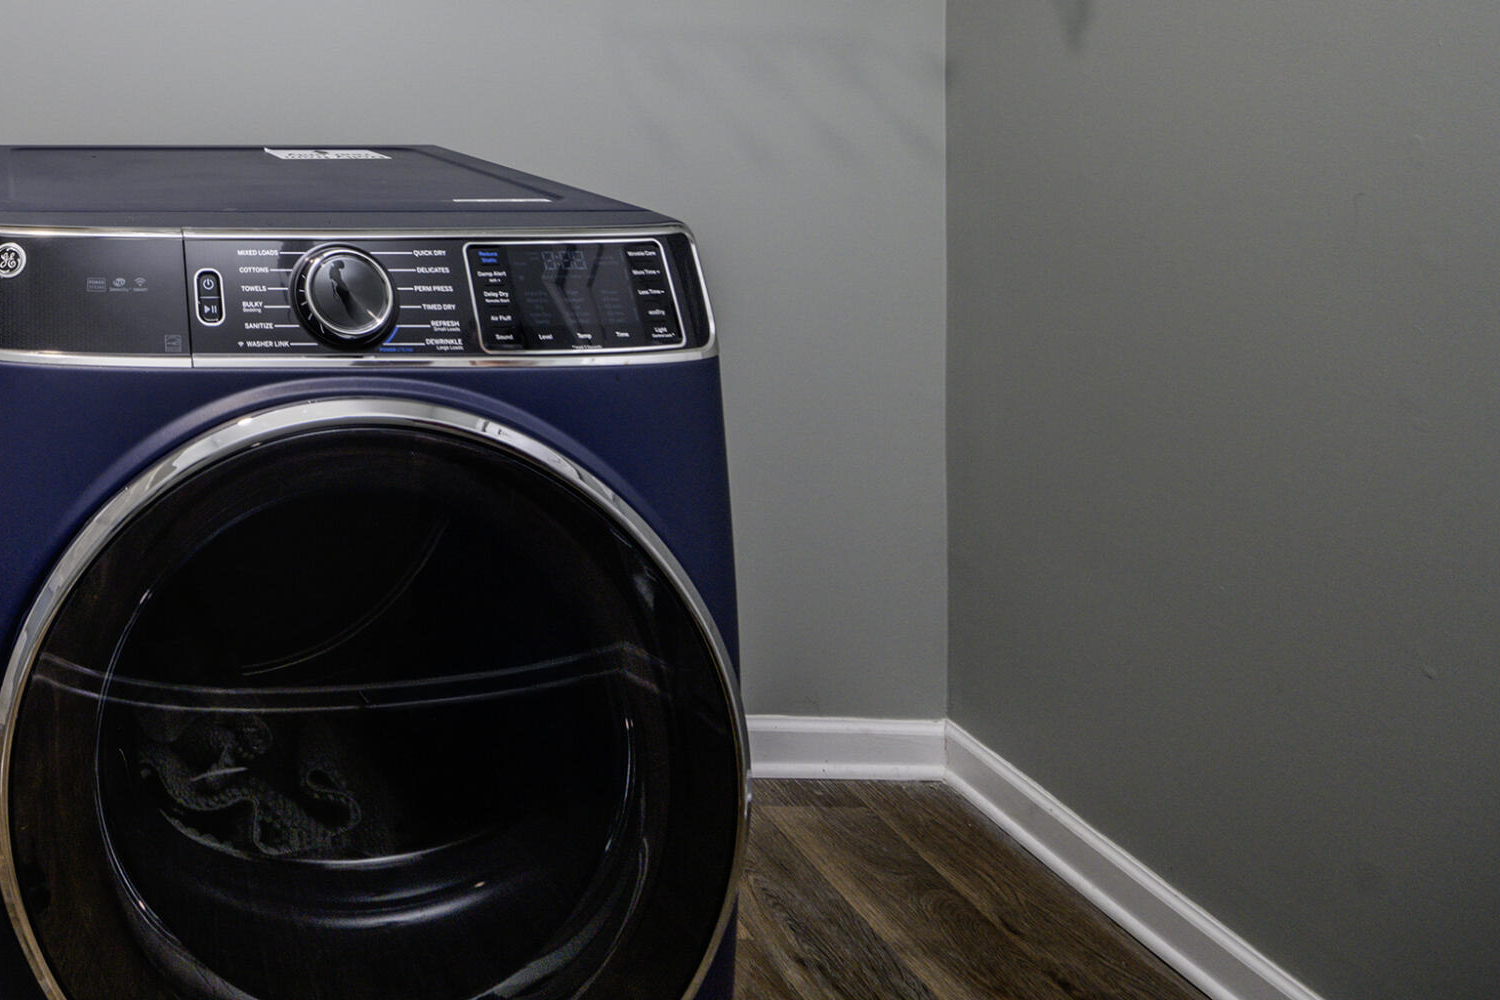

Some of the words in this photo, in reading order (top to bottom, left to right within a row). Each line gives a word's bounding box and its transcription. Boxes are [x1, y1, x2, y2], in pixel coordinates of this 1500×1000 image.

[414, 285, 433, 293] PERM
[433, 285, 454, 293] PRESS
[244, 322, 274, 330] SANITIZE
[494, 333, 514, 341] Sound
[246, 340, 274, 348] WASHER
[274, 340, 290, 348] LINK
[425, 338, 463, 346] DEWRINKLE
